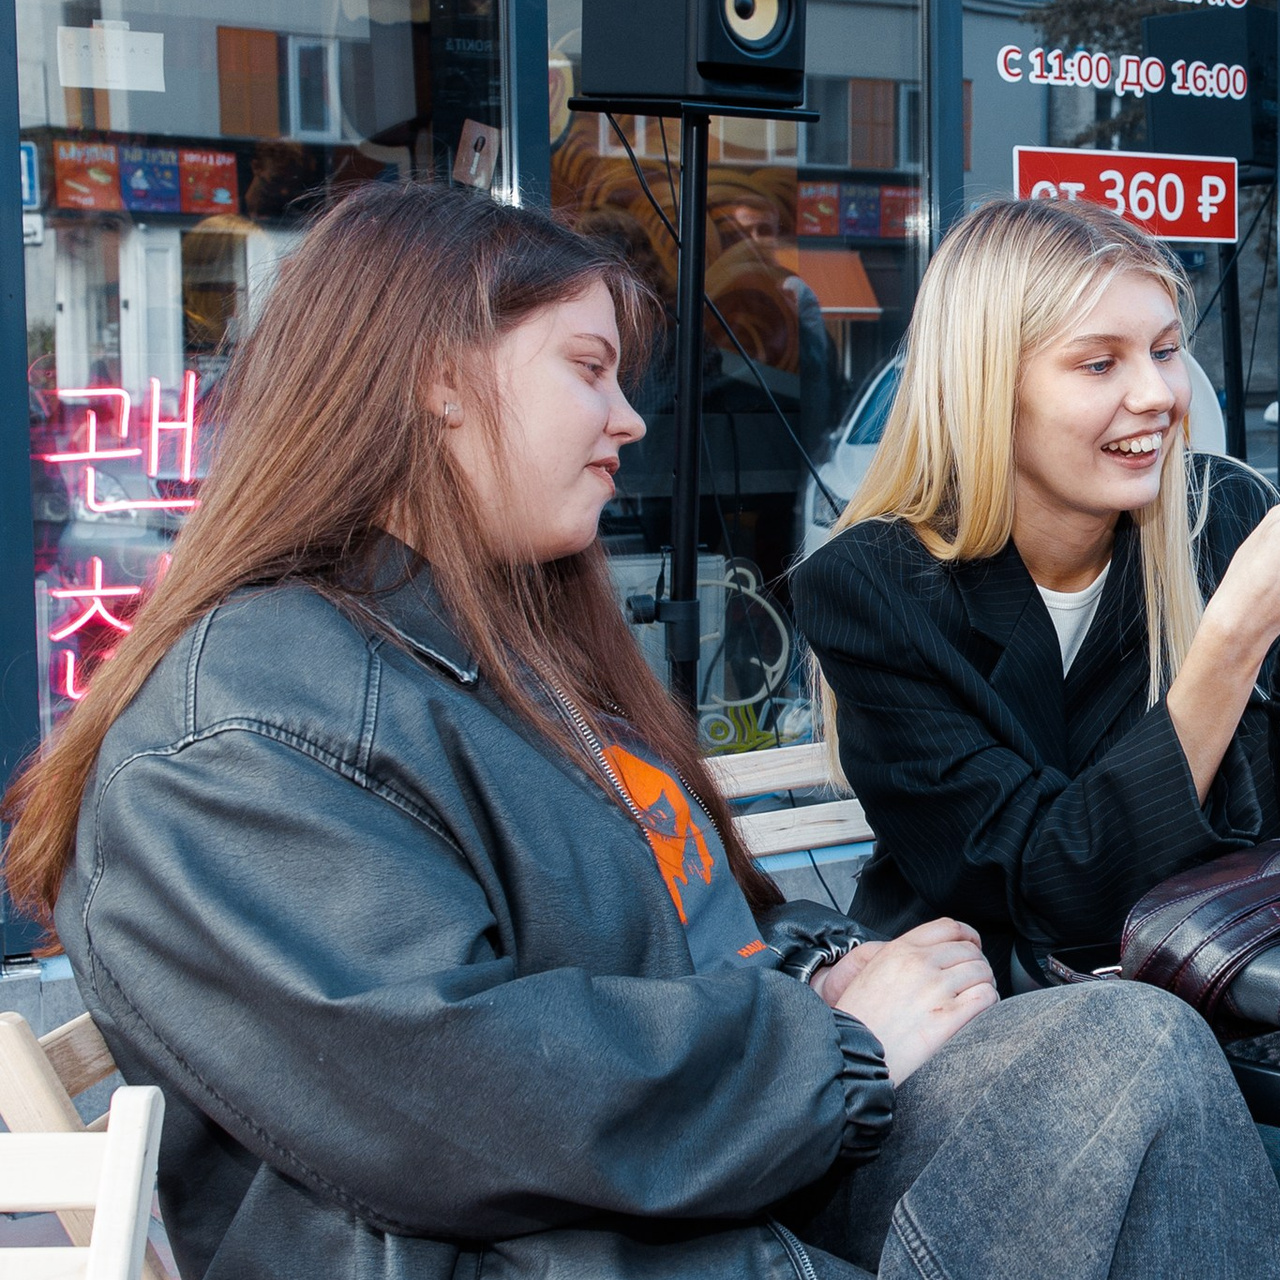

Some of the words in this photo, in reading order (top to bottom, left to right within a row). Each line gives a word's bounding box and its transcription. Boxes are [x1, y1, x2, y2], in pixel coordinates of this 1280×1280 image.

[998, 46, 1022, 81] С
[1030, 48, 1112, 88] 11:00
[1116, 56, 1165, 97] ДО
[1173, 61, 1248, 99] 16:00
[1099, 169, 1185, 222] 360
[1197, 175, 1227, 222] ₽
